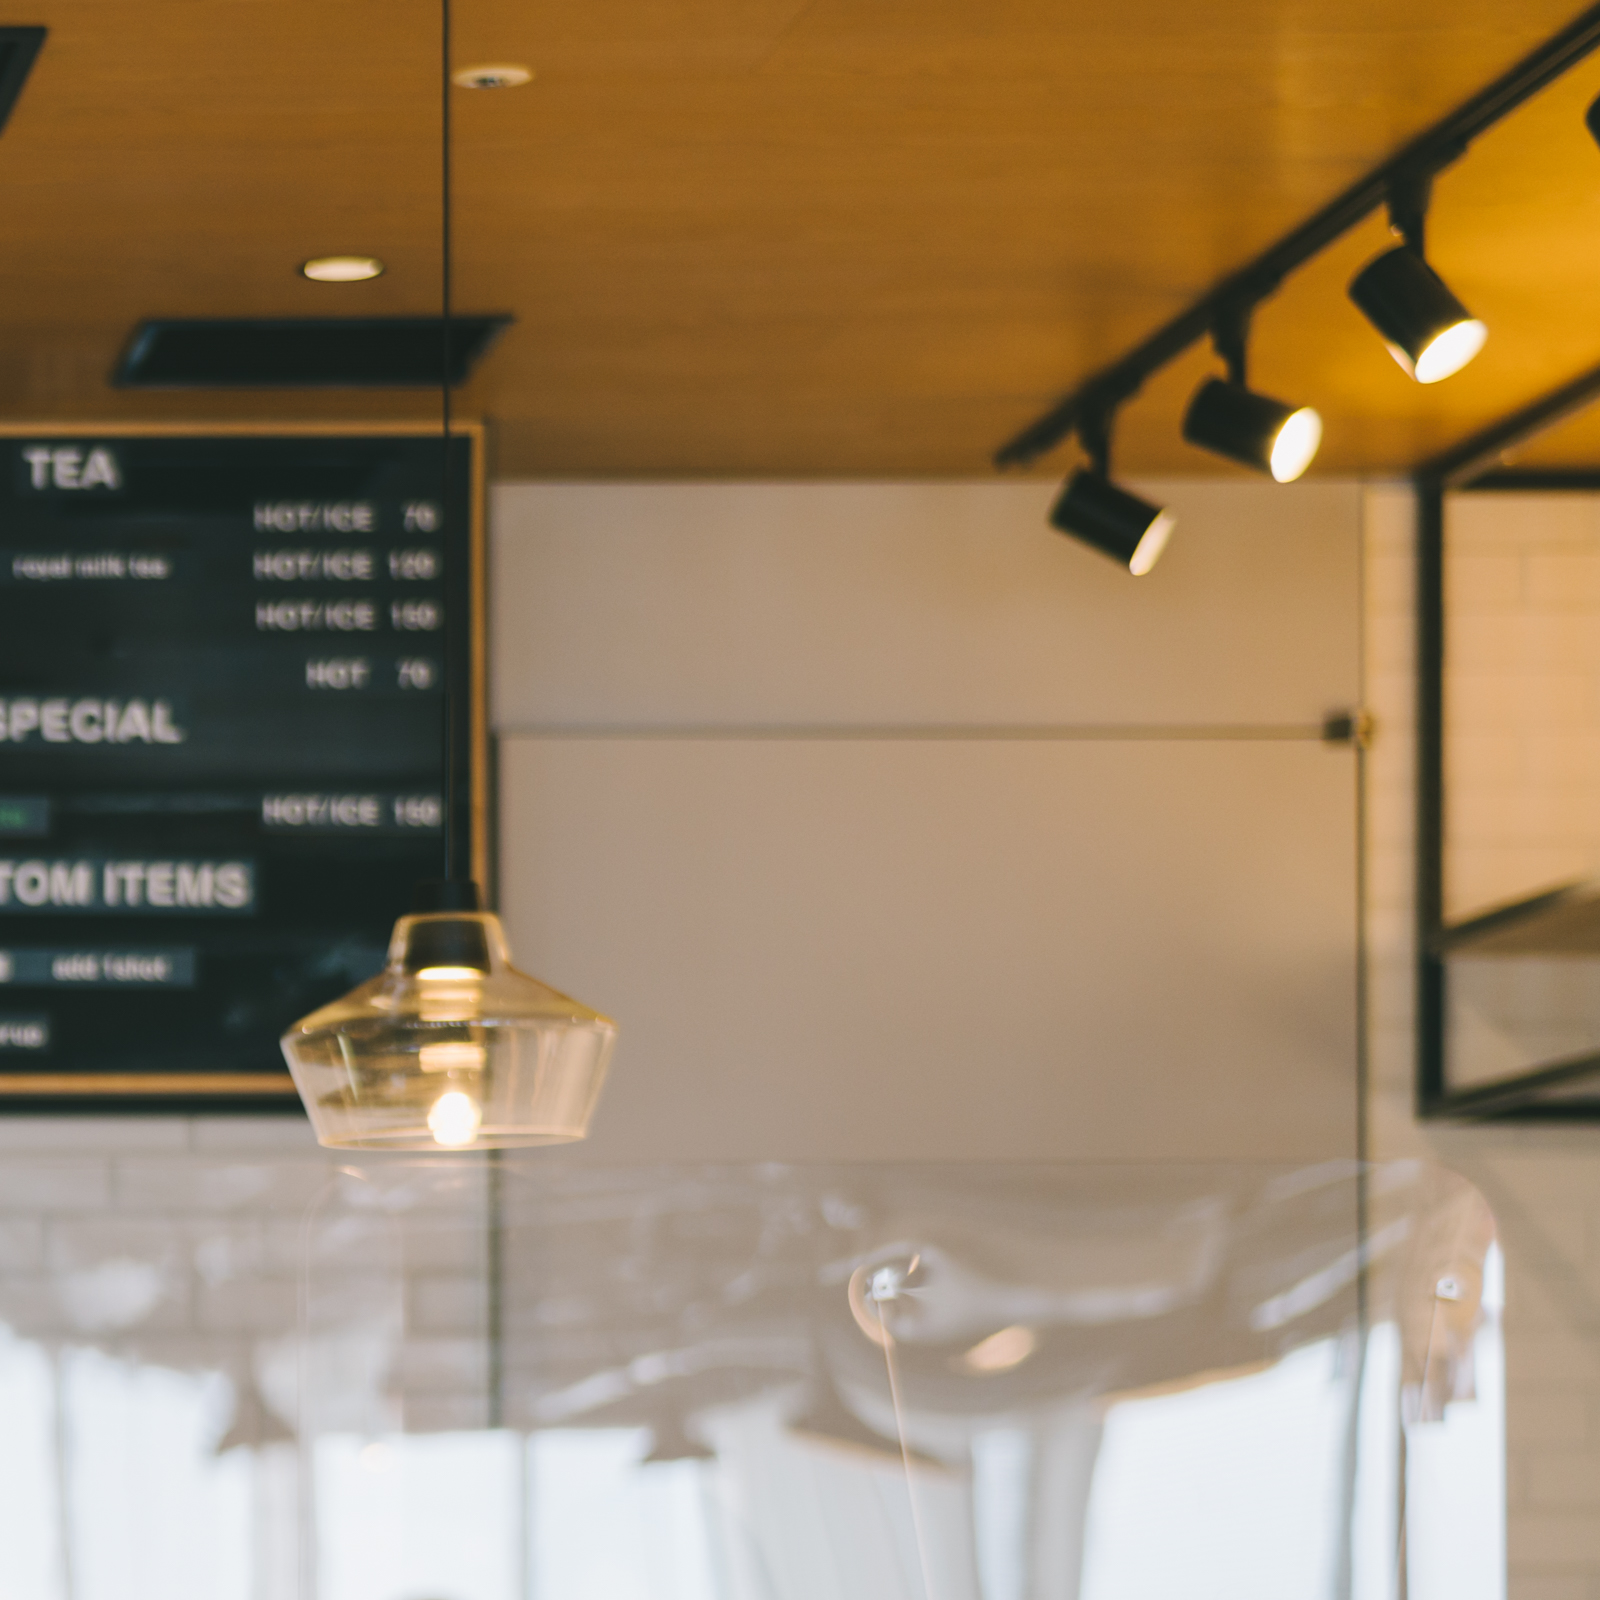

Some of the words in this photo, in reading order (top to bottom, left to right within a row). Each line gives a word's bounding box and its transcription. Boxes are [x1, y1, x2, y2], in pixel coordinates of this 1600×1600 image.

[25, 448, 116, 488] TEA
[254, 505, 372, 531] HOT/ICE
[254, 553, 371, 579] HOT/ICE
[256, 603, 373, 629] HOT/ICE
[306, 661, 366, 688] HOT
[263, 797, 379, 825] HOT/ICE
[103, 863, 249, 907] ITEMS
